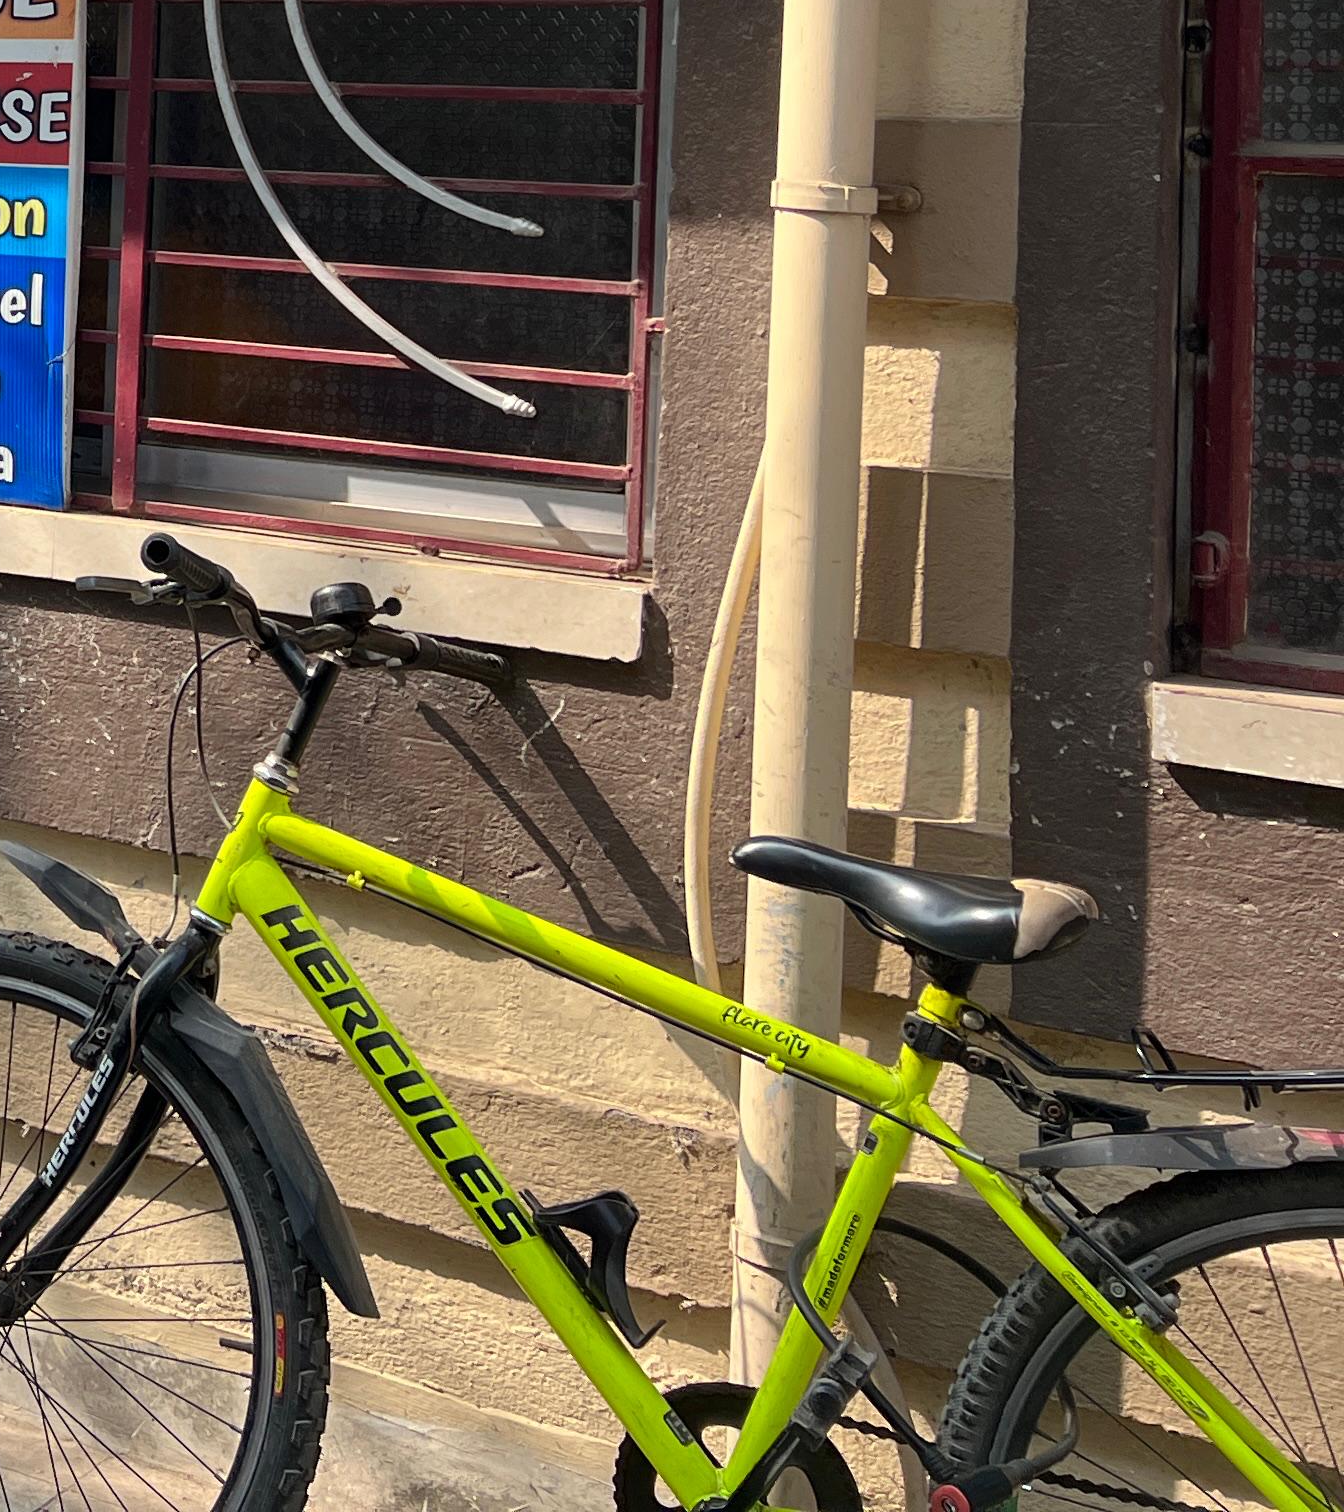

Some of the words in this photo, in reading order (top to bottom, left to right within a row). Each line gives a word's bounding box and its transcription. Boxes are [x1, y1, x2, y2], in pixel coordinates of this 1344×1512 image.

[261, 904, 534, 1246] HERCULES
[722, 1005, 772, 1039] flare
[775, 1029, 811, 1059] city
[40, 1054, 114, 1188] HERCULES
[817, 1214, 862, 1310] #madeformore
